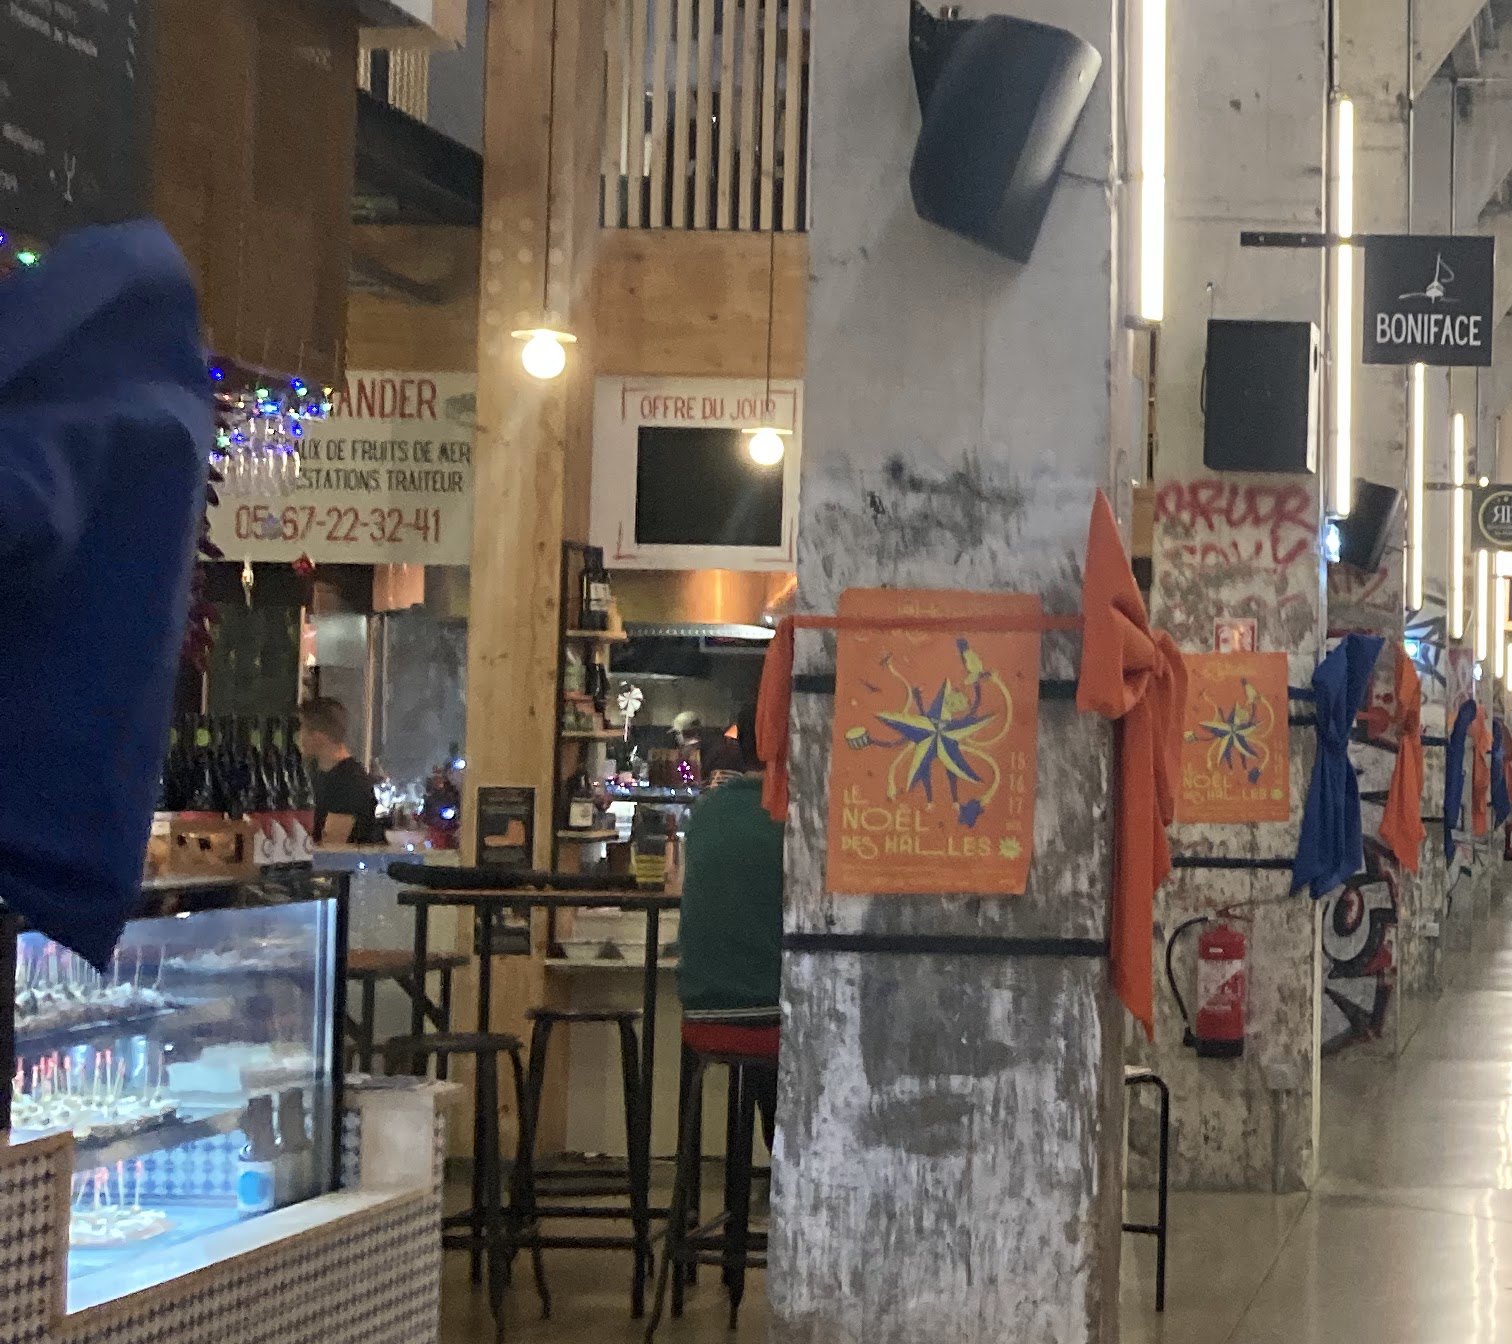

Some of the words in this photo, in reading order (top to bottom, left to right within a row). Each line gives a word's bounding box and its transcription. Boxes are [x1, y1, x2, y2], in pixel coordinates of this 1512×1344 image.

[1376, 313, 1482, 346] BONIFACE
[330, 378, 437, 420] ANDER
[641, 396, 695, 419] OFFRE
[702, 397, 724, 420] DU
[730, 398, 776, 422] JOUR
[326, 439, 346, 461] DE
[351, 439, 408, 462] FRUITS
[413, 440, 433, 463] DE
[386, 469, 463, 493] TRAITEUR
[843, 785, 869, 805] LE
